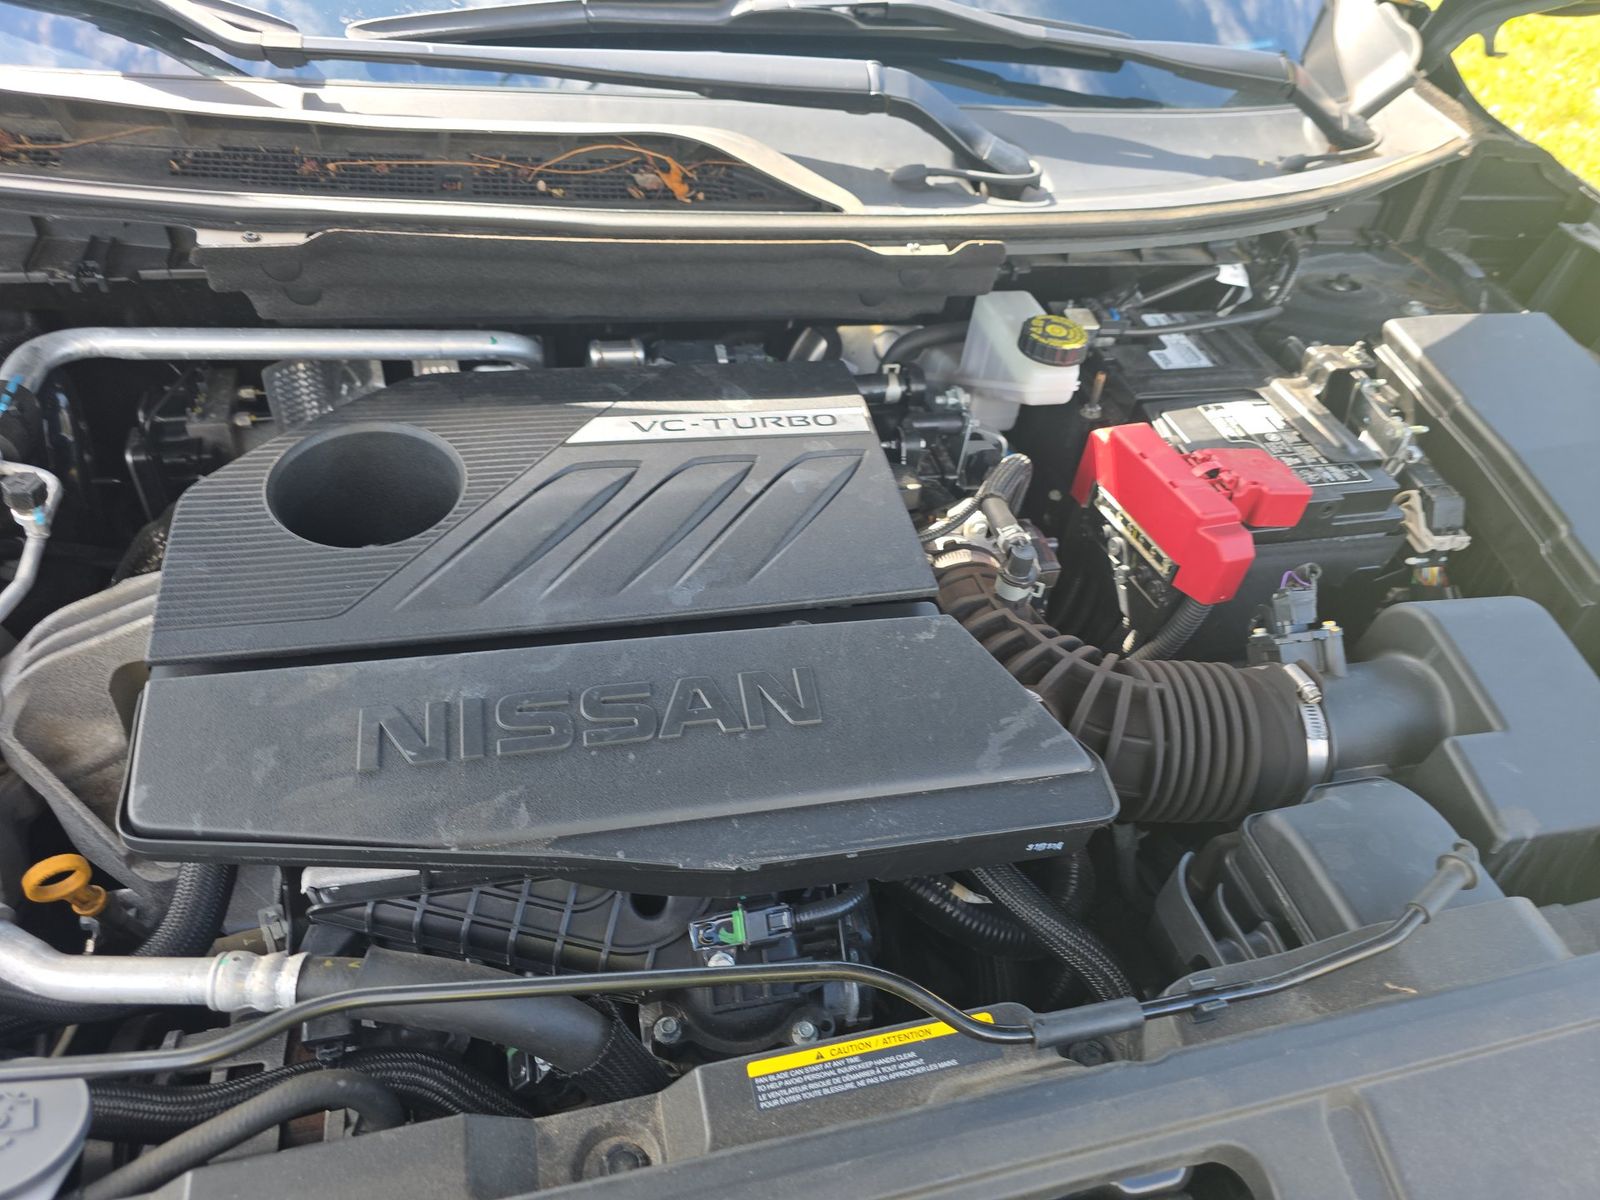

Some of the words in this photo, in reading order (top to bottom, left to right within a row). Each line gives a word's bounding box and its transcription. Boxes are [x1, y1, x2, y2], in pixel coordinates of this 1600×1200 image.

[631, 413, 837, 432] VC-TURBO
[357, 667, 822, 771] NISSAN
[829, 1041, 871, 1056] CAUTION
[882, 1027, 931, 1045] ATTENTION
[756, 1084, 766, 1092] TO
[783, 1075, 804, 1086] AVOID
[803, 1068, 837, 1082] PERSONAL
[873, 1055, 896, 1066] HANDS
[804, 1063, 823, 1073] START
[831, 1076, 842, 1084] DE
